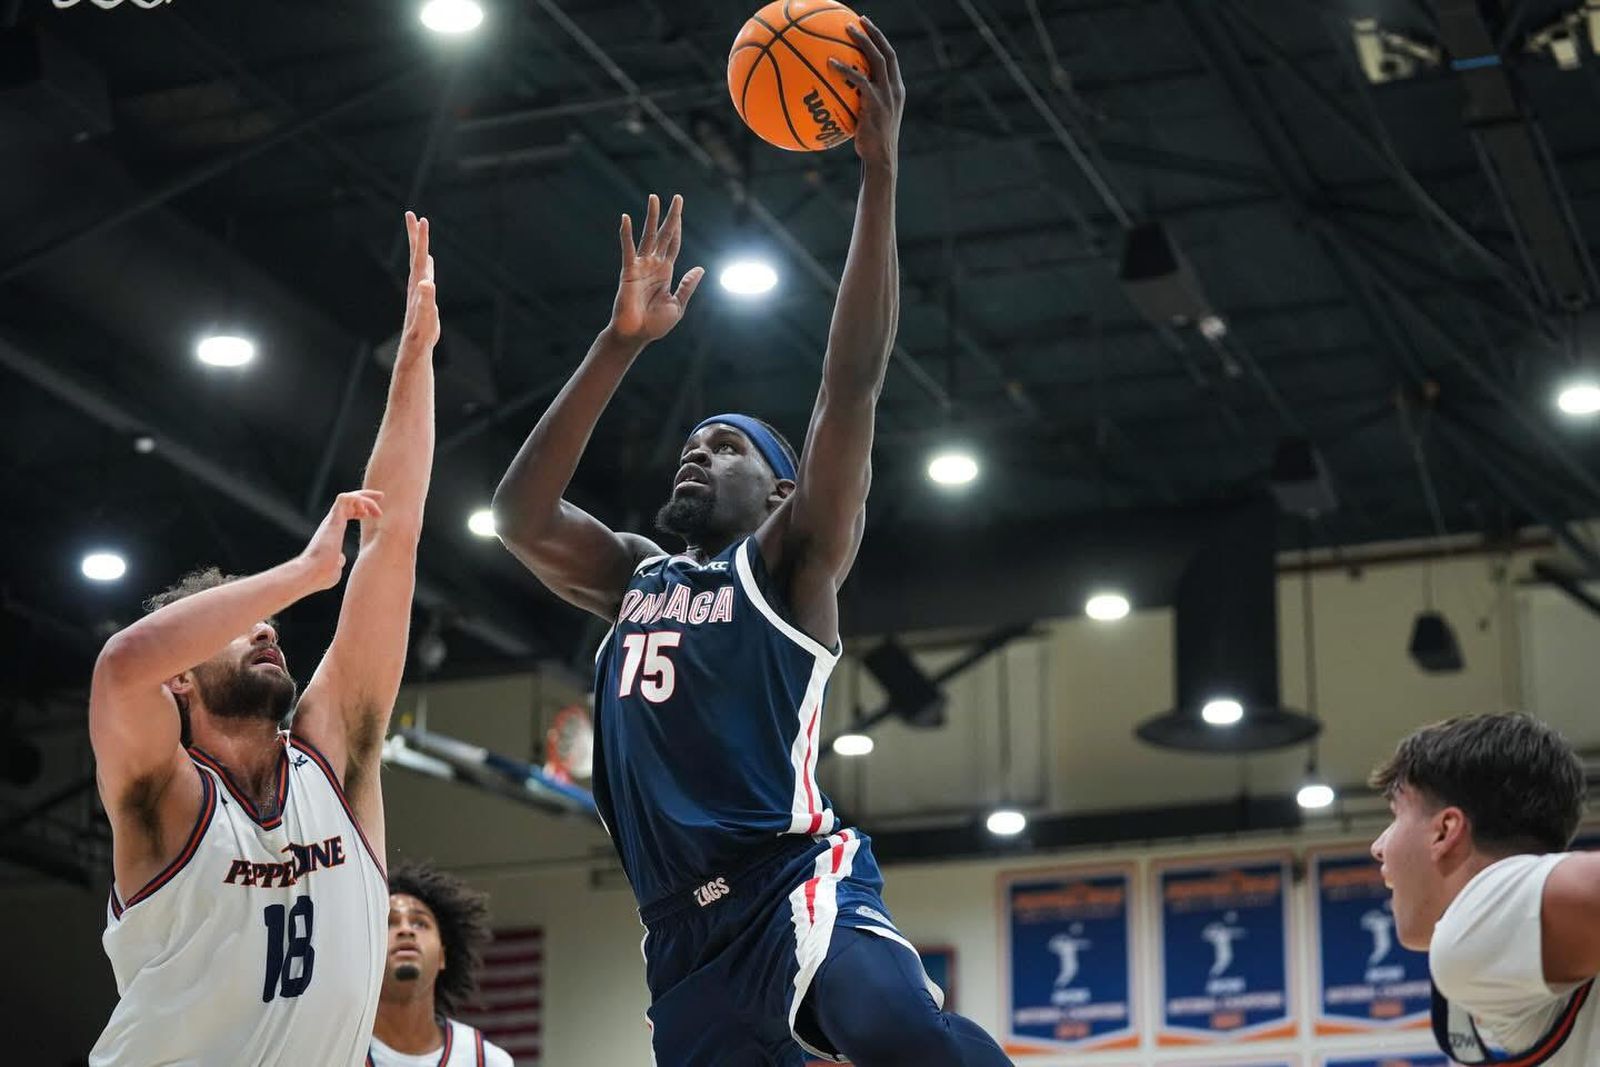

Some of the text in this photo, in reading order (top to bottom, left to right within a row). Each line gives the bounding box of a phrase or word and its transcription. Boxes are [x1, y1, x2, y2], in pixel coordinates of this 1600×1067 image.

[619, 631, 682, 704] 15
[693, 877, 730, 907] ZAGS
[263, 896, 315, 1004] 18
